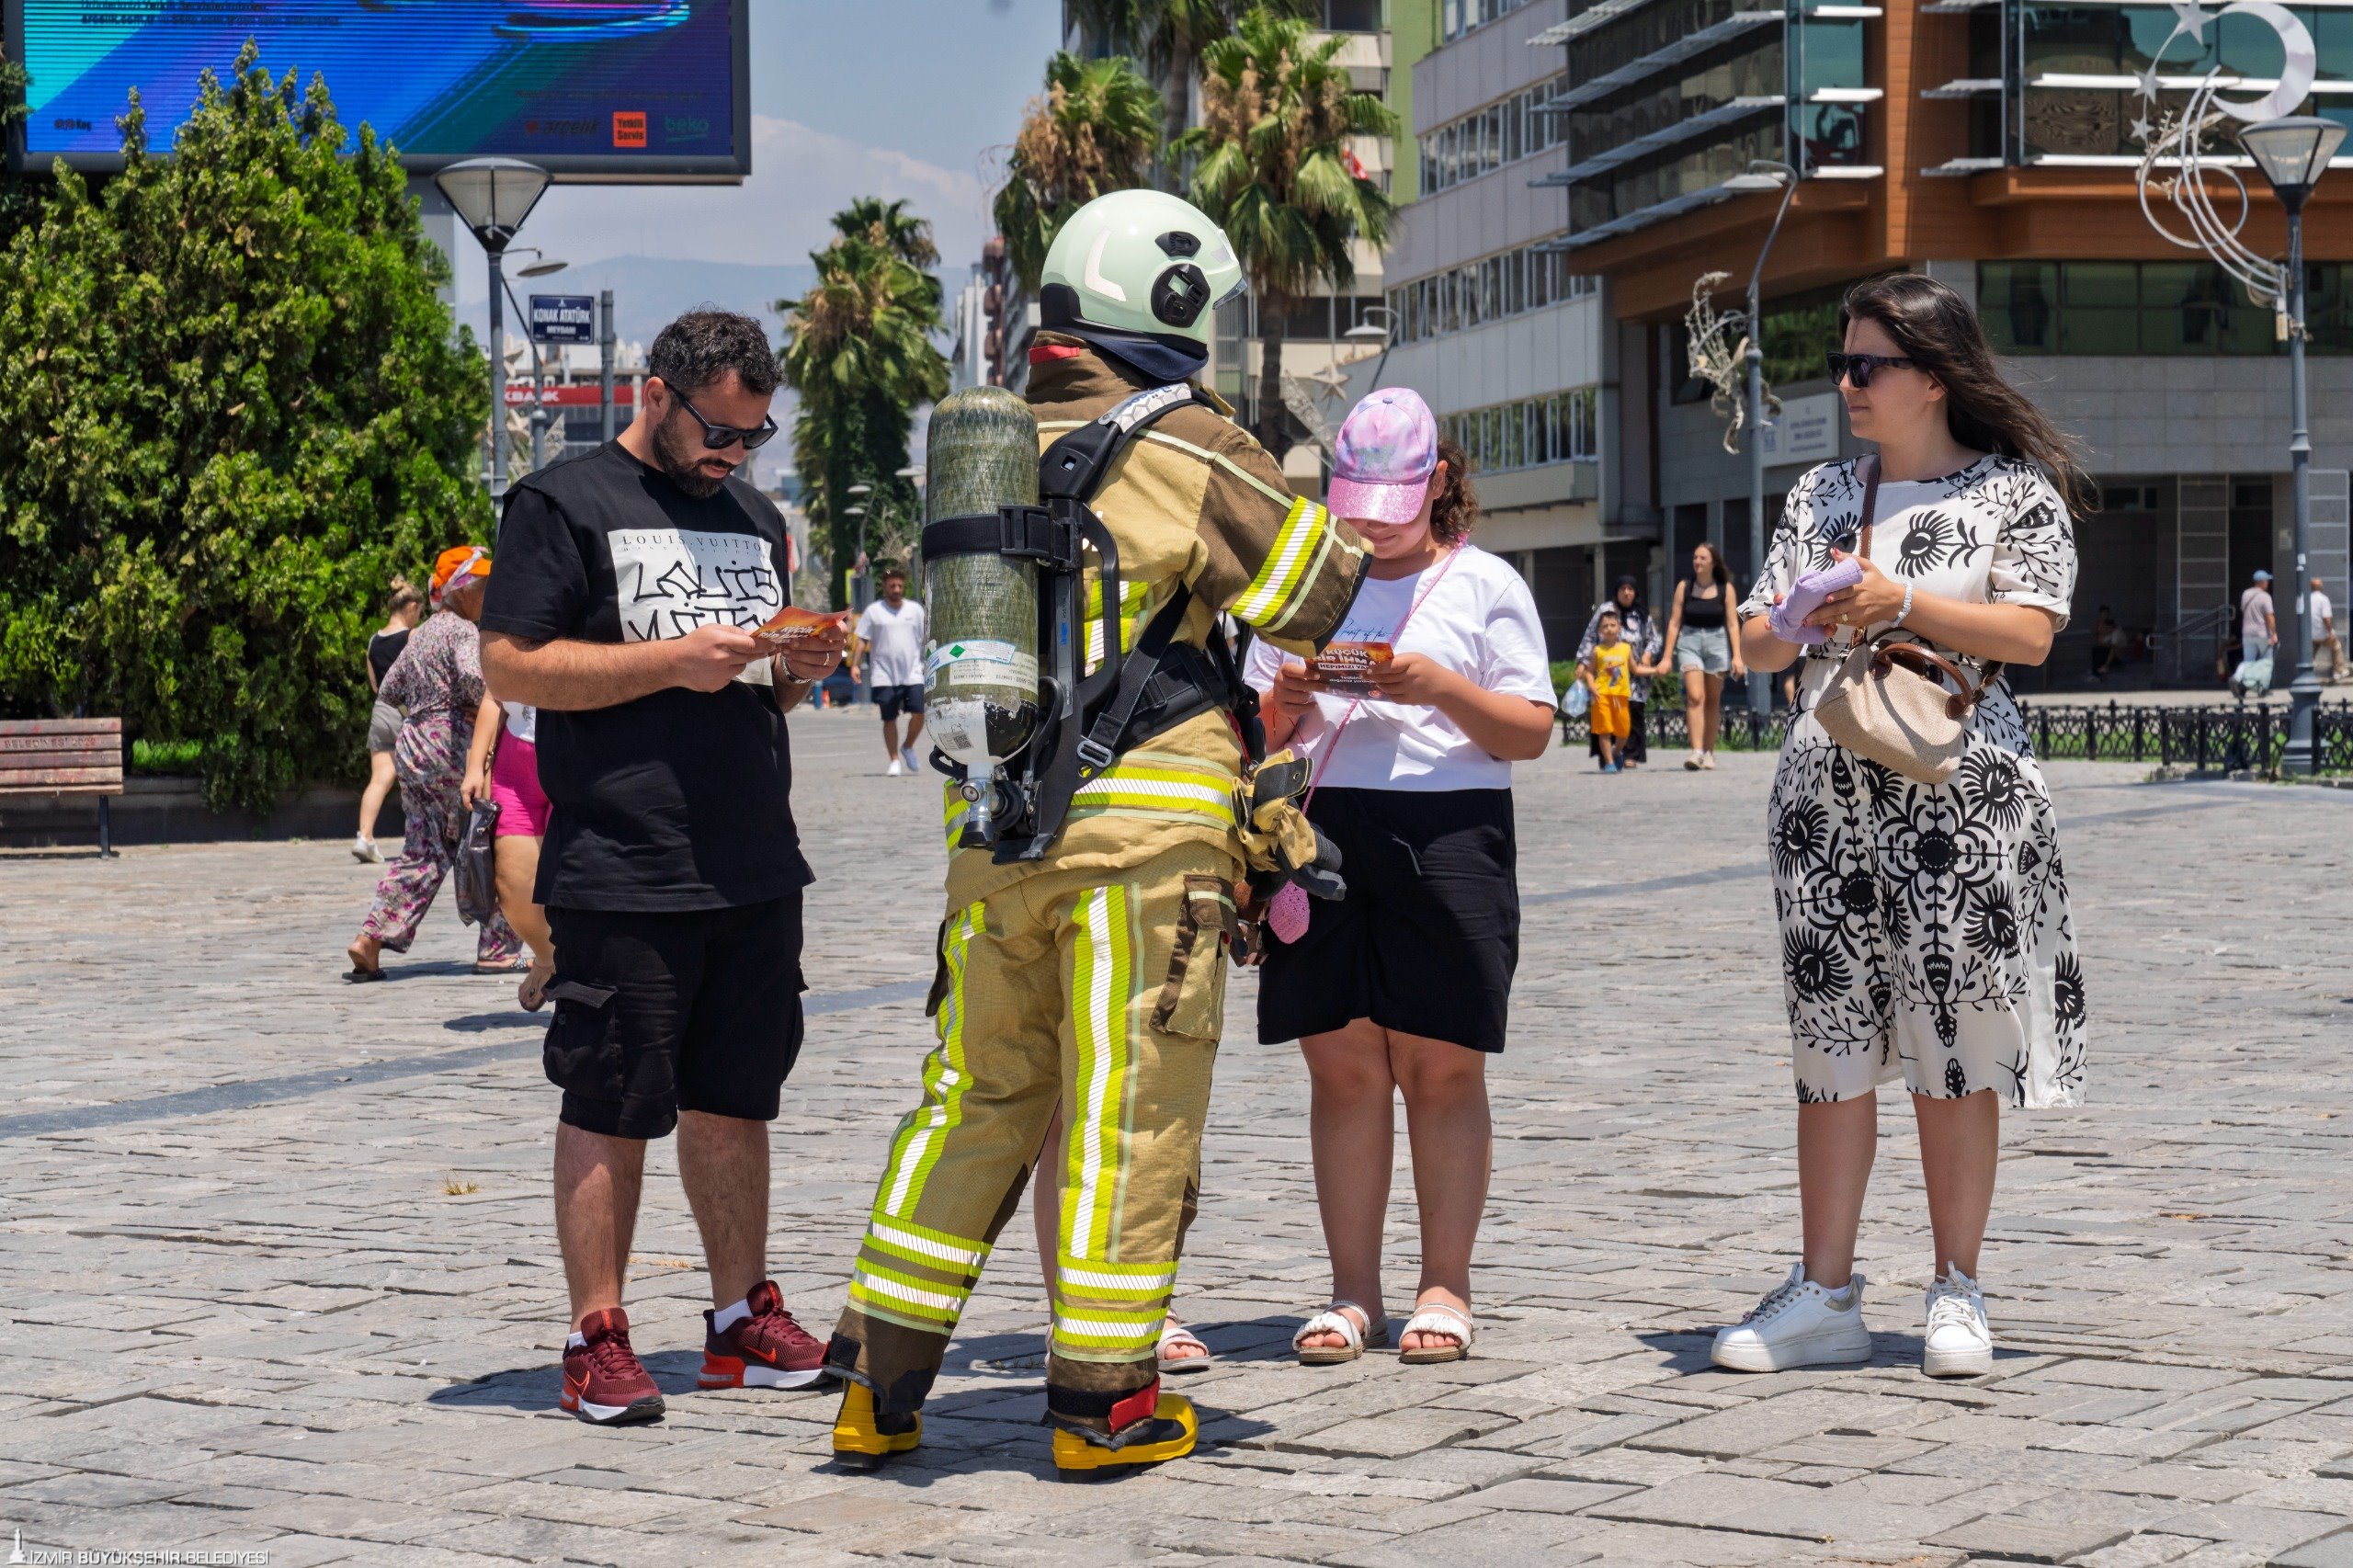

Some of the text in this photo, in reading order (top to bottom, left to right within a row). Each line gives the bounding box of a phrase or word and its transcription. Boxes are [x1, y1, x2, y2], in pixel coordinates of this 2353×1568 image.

[534, 306, 590, 324] KONAK ATATÜRK
[505, 391, 560, 403] KBANK
[696, 537, 770, 552] VUITTO
[1338, 653, 1376, 665] İHMA
